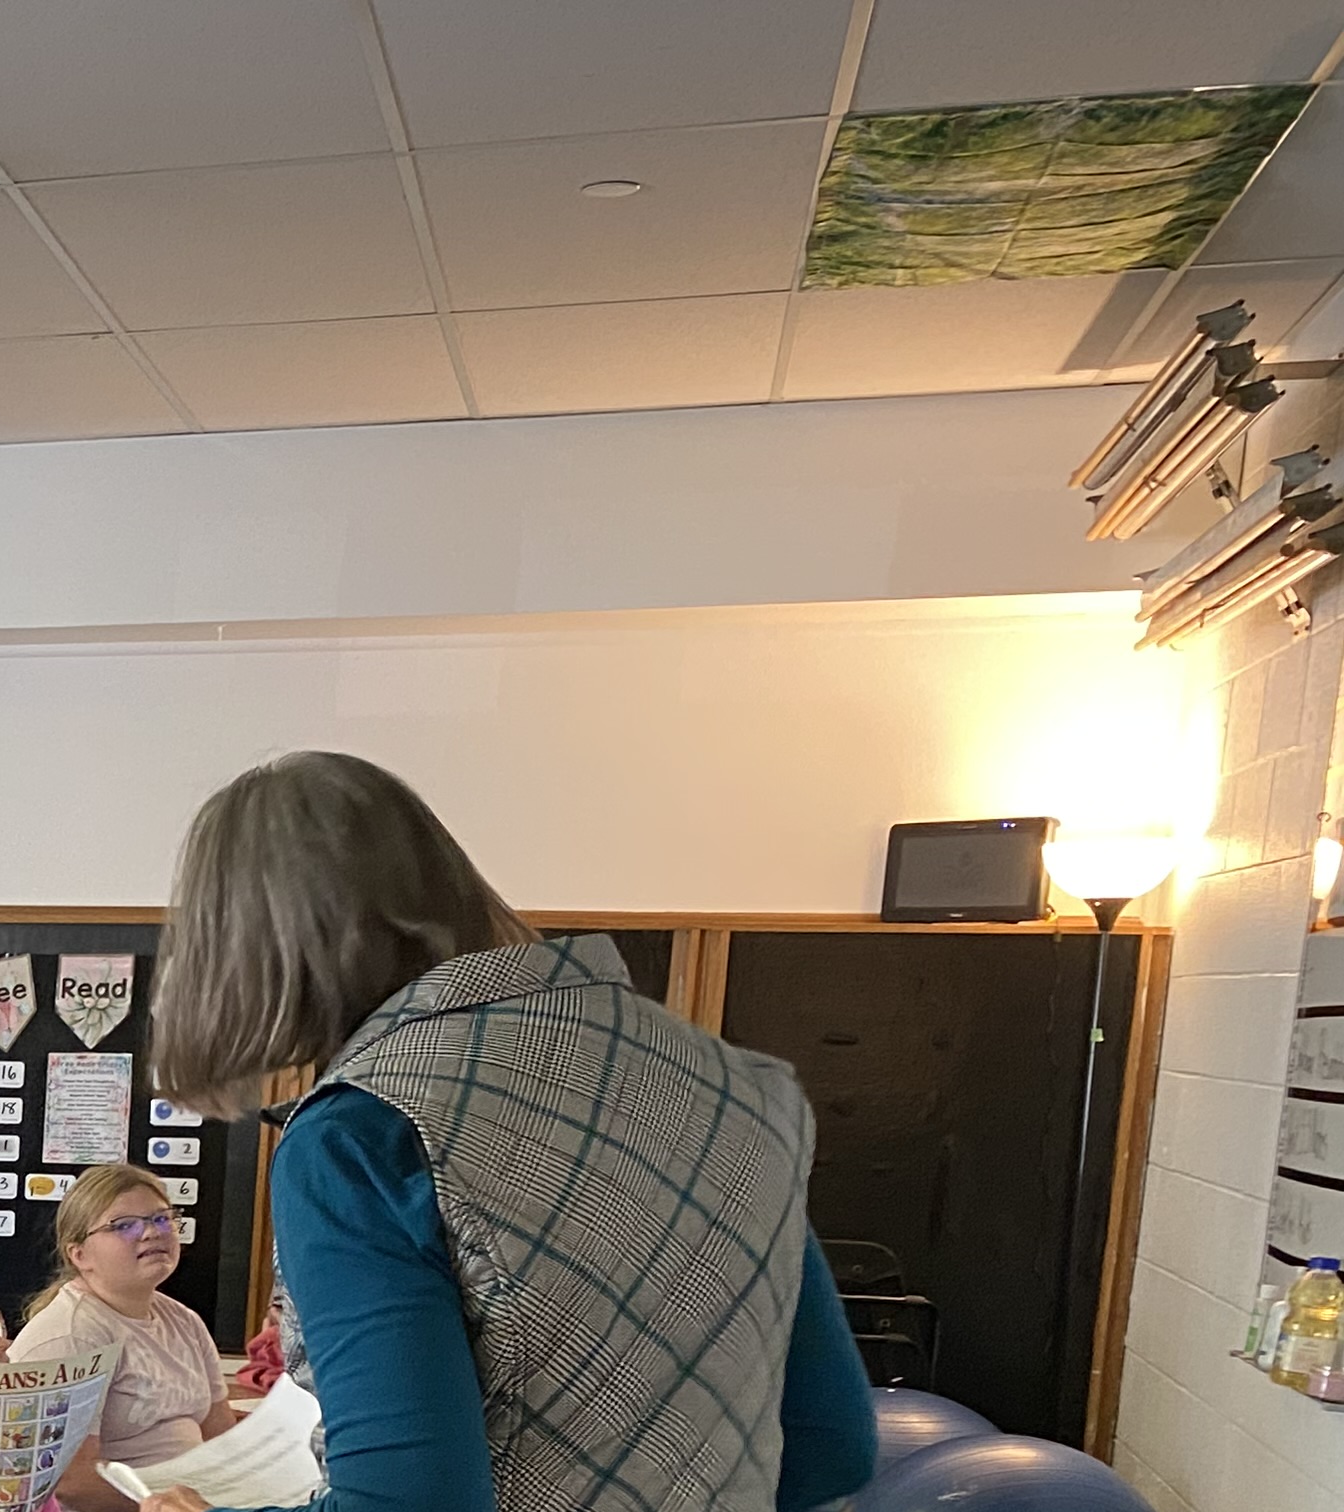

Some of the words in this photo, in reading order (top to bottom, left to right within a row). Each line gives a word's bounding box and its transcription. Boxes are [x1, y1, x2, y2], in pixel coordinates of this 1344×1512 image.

[61, 978, 128, 1000] Read
[2, 1065, 17, 1080] 16
[1, 1102, 17, 1115] 18
[183, 1143, 192, 1154] 2
[0, 1177, 9, 1190] 3
[60, 1179, 68, 1193] 4
[180, 1181, 189, 1195] 6
[0, 1215, 8, 1228] 7
[53, 1363, 68, 1383] A
[73, 1366, 85, 1381] to
[89, 1354, 103, 1376] Z
